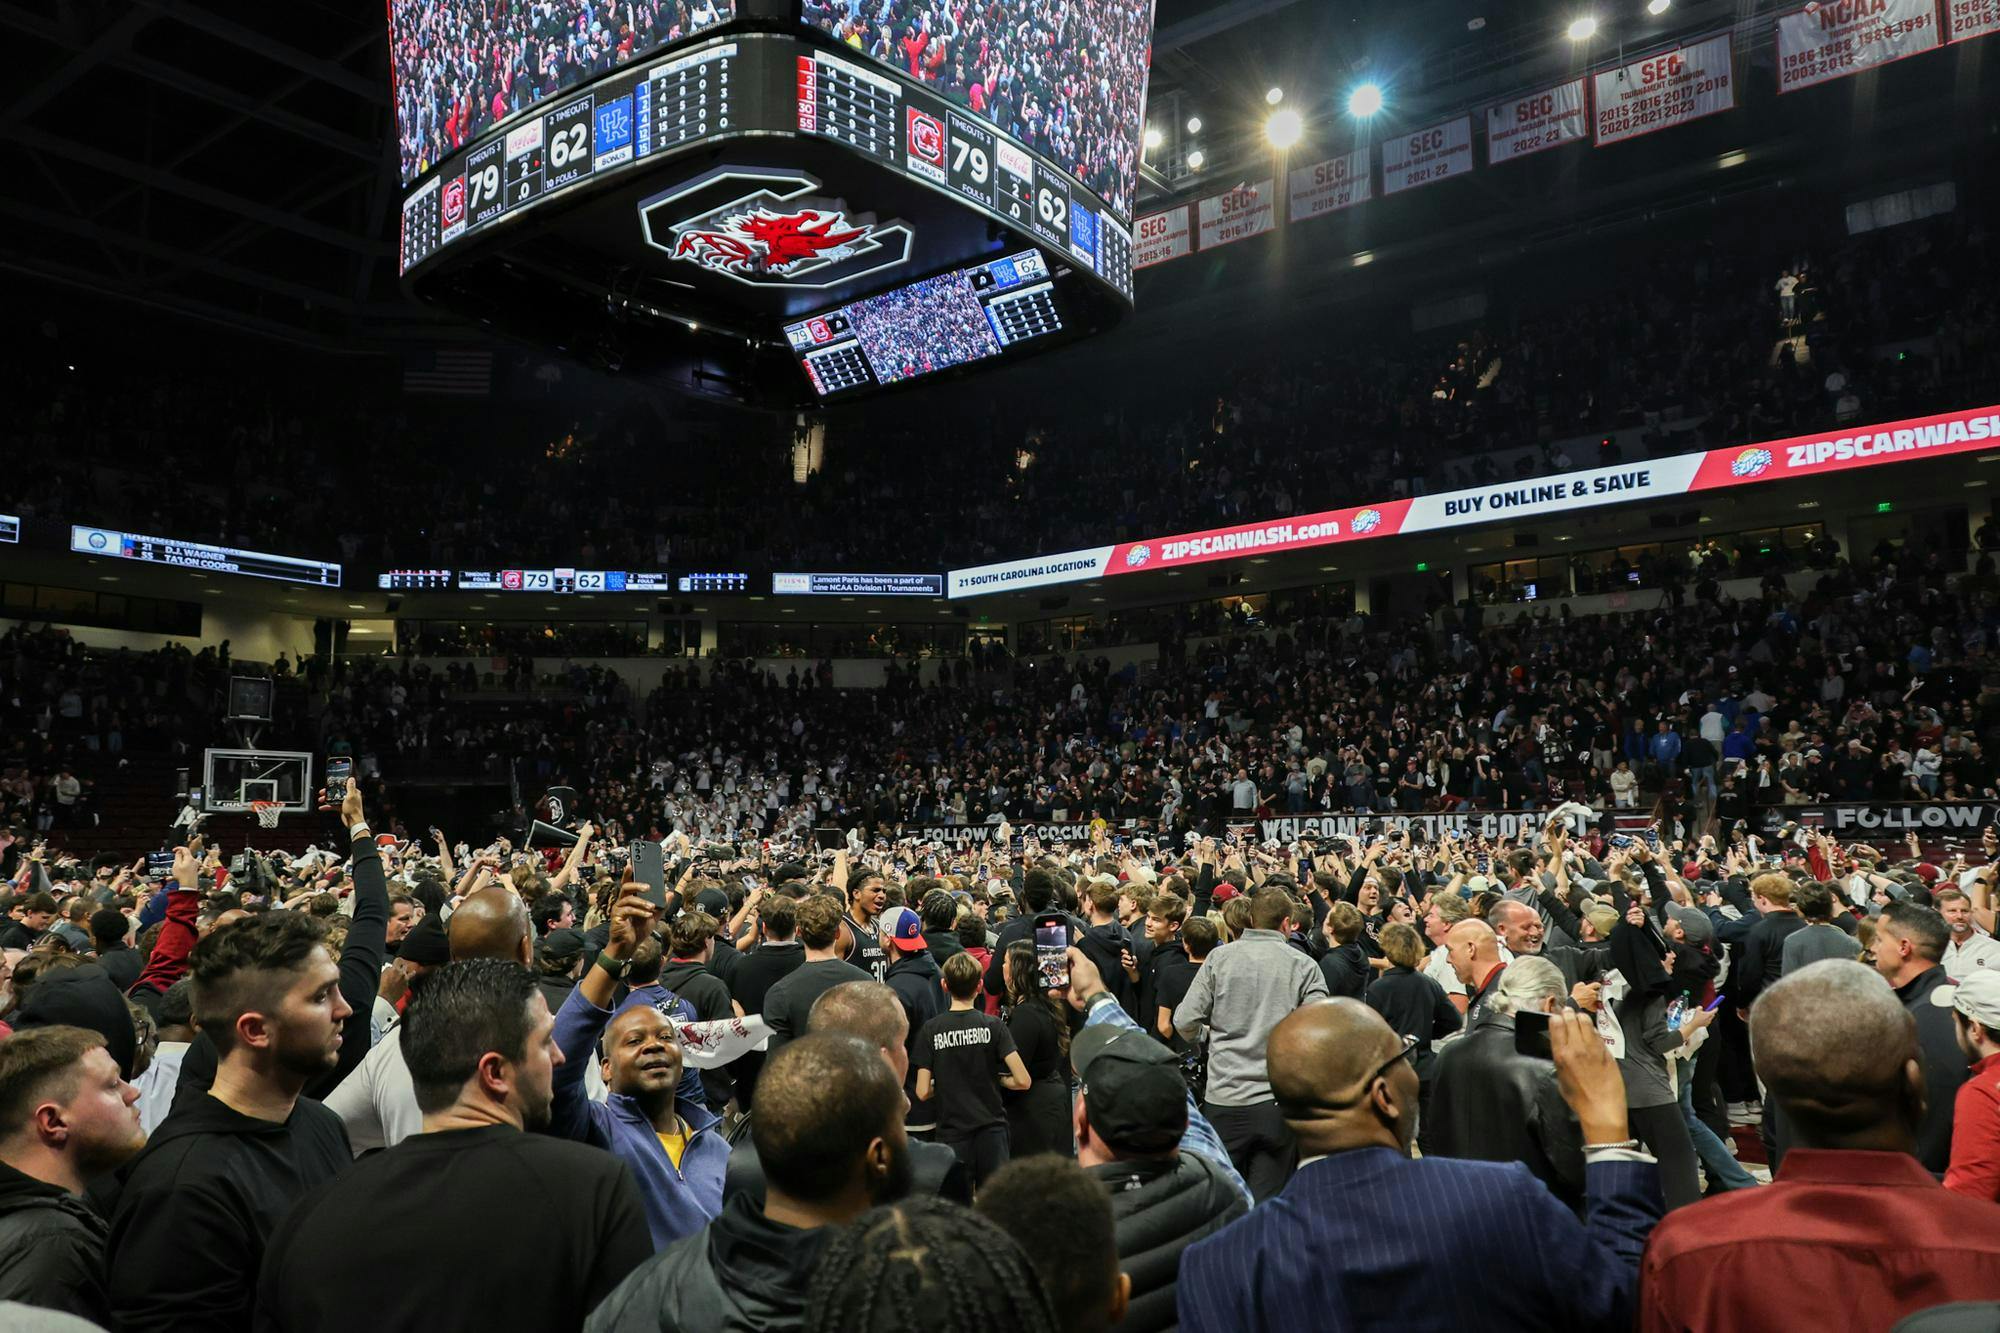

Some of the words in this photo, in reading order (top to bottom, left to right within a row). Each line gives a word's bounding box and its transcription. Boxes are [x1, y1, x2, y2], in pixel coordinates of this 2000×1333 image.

[1820, 0, 1886, 30] NCAA
[660, 78, 666, 89] 2
[680, 71, 686, 82] 2
[699, 64, 707, 75] 0
[720, 58, 728, 69] 2
[1641, 54, 1681, 84] SEC
[660, 92, 667, 103] 4
[699, 79, 707, 90] 0
[720, 73, 728, 84] 3
[699, 93, 706, 105] 2
[720, 87, 728, 99] 3
[806, 75, 813, 86] 2
[849, 90, 855, 100] 7
[870, 99, 874, 110] 1
[889, 108, 895, 119] 2
[826, 67, 837, 80] 14
[849, 76, 855, 88] 2
[870, 85, 874, 95] 1
[889, 94, 894, 104] 1
[1620, 82, 1665, 101] TOURNAMENT
[556, 100, 589, 122] TIMEOUTS
[806, 90, 813, 100] 5
[826, 95, 837, 108] 14
[849, 105, 856, 116] 2
[1516, 94, 1553, 122] SEC
[1600, 104, 1629, 123] 2015
[1632, 95, 1661, 114] 2016
[1664, 85, 1693, 104] 2017
[1696, 75, 1728, 95] 2018
[679, 114, 686, 126] 4
[699, 108, 707, 119] 0
[720, 102, 728, 114] 2
[699, 123, 707, 134] 0
[720, 117, 728, 129] 0
[798, 102, 813, 114] 30
[828, 111, 835, 122] 6
[889, 136, 895, 146] 2
[1600, 118, 1629, 137] 2020
[1632, 109, 1662, 127] 2021
[1664, 99, 1695, 117] 2023
[951, 116, 984, 141] TIMEOUTS
[550, 122, 588, 168] 62
[825, 124, 838, 137] 20
[849, 133, 856, 144] 6
[889, 149, 894, 160] 1
[1410, 130, 1443, 156] SEC
[469, 147, 495, 167] TIMEOUTS
[951, 135, 989, 184] 79
[521, 162, 528, 177] 2
[555, 168, 578, 185] FOULS
[1043, 169, 1068, 193] TIMEOUTS
[1314, 160, 1345, 185] SEC
[469, 164, 499, 209] 79
[962, 183, 984, 201] FOULS
[1012, 183, 1019, 198] 2
[477, 206, 495, 222] FOULS
[1038, 188, 1067, 232] 62
[1140, 216, 1167, 239] SEC
[1021, 259, 1036, 273] 62
[793, 330, 808, 342] 79
[1445, 496, 1484, 516] BUY
[1489, 483, 1566, 509] ONLINE
[1571, 480, 1588, 496] &
[1593, 470, 1651, 494] SAVE
[142, 542, 152, 551] 21
[164, 545, 181, 555] D.J.
[183, 547, 226, 561] WAGNER
[1161, 521, 1340, 561] ZIPSCARWASH.com
[200, 560, 239, 572] COOPER
[959, 578, 969, 587] 21
[971, 573, 998, 586] SOUTH
[1000, 567, 1044, 581] CAROLINA
[1046, 558, 1096, 574] LOCATIONS
[527, 574, 549, 587] 79
[579, 574, 601, 588] 62
[813, 576, 841, 584] Lamont
[842, 576, 859, 584] Paris
[899, 578, 917, 586] part
[887, 584, 934, 592] Tournaments
[1262, 816, 1374, 843] WELCOME
[1381, 815, 1410, 841] TO
[1422, 814, 1468, 842] THE
[1482, 811, 1603, 840] COCI
[1837, 806, 1983, 829] FOLLOW
[924, 827, 989, 842] FOLLOW
[862, 947, 886, 958] GAMEC
[870, 960, 887, 985] 30
[933, 1027, 991, 1050] #BACKTHEBIRD
